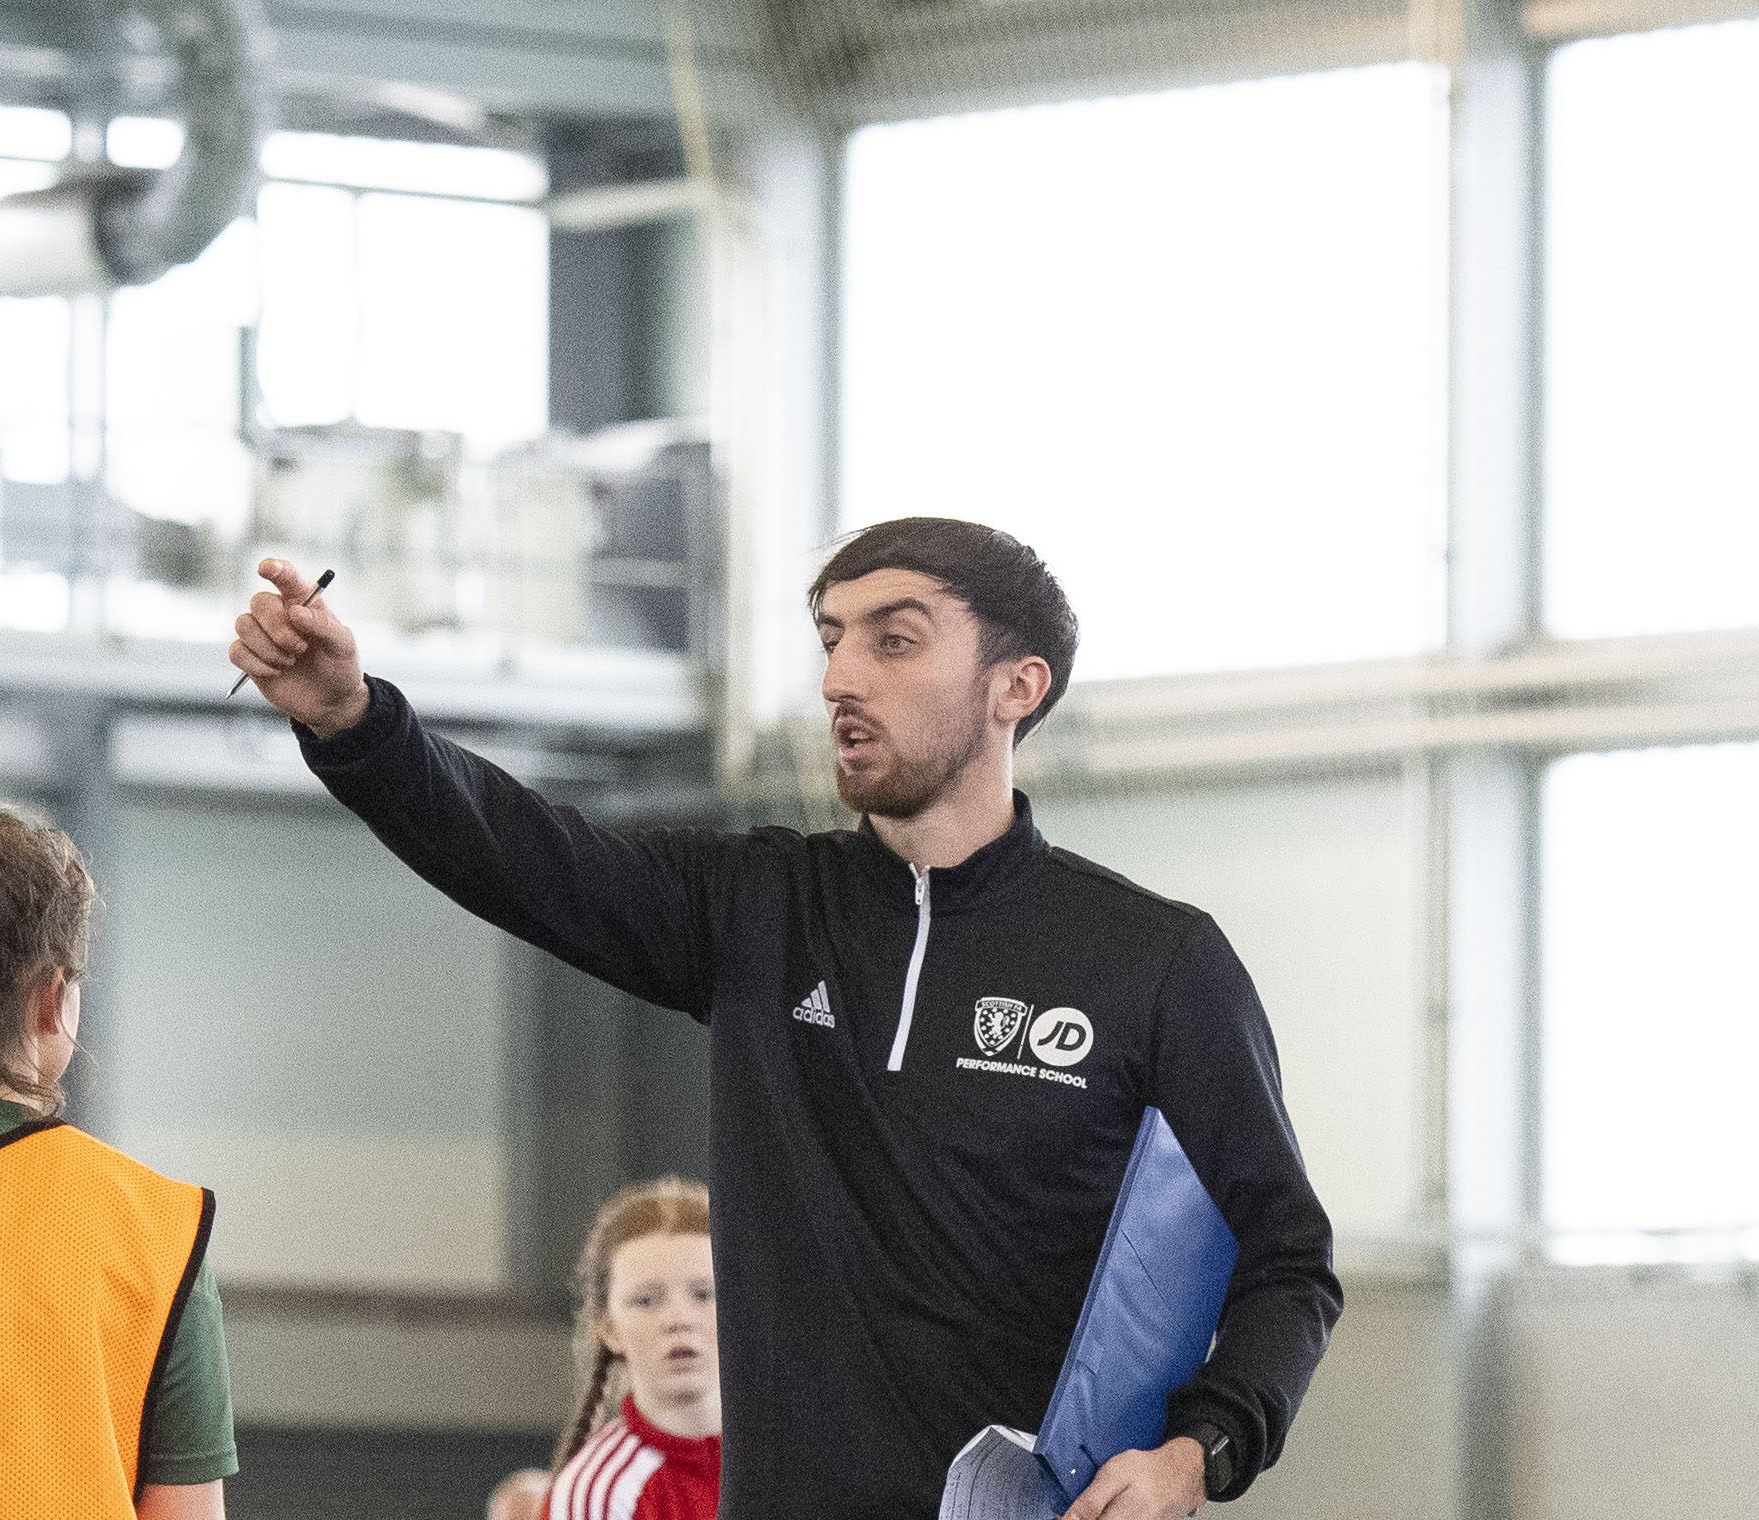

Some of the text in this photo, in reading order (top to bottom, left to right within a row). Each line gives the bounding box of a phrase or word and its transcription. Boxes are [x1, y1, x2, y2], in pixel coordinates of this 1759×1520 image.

[793, 1007, 835, 1029] adidas
[1037, 1020, 1087, 1051] JD
[956, 1057, 1088, 1089] PERFORMANCE SCHOOL
